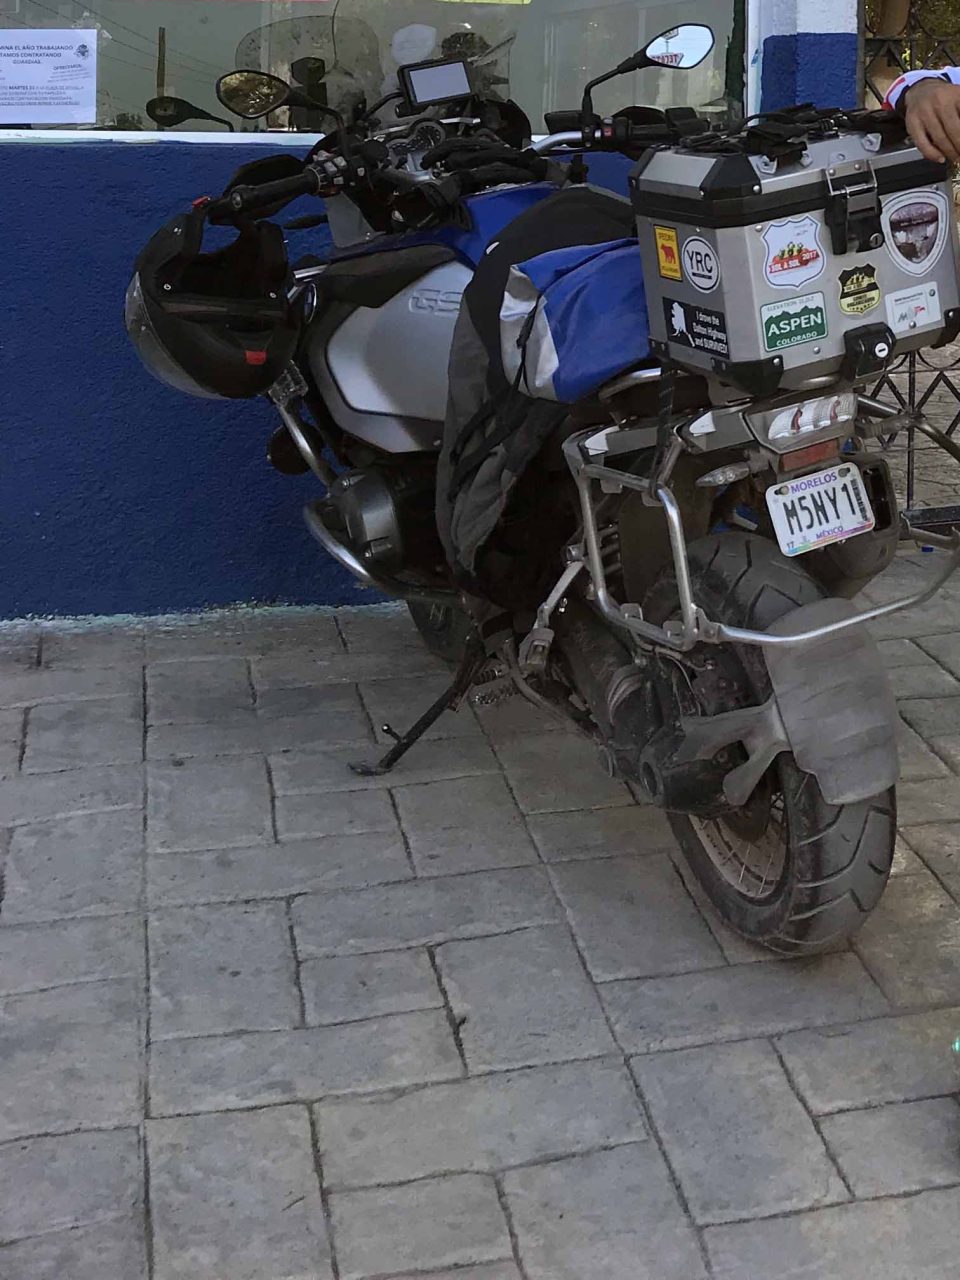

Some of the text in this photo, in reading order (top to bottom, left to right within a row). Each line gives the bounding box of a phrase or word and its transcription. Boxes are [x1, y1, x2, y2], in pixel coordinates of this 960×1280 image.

[686, 250, 713, 273] YRC
[802, 250, 817, 261] 2017
[768, 312, 822, 337] ASPEN
[776, 331, 818, 346] COLORADO
[790, 471, 838, 494] MORELOS
[783, 483, 856, 535] M5NY1
[815, 525, 844, 539] MÉXICO
